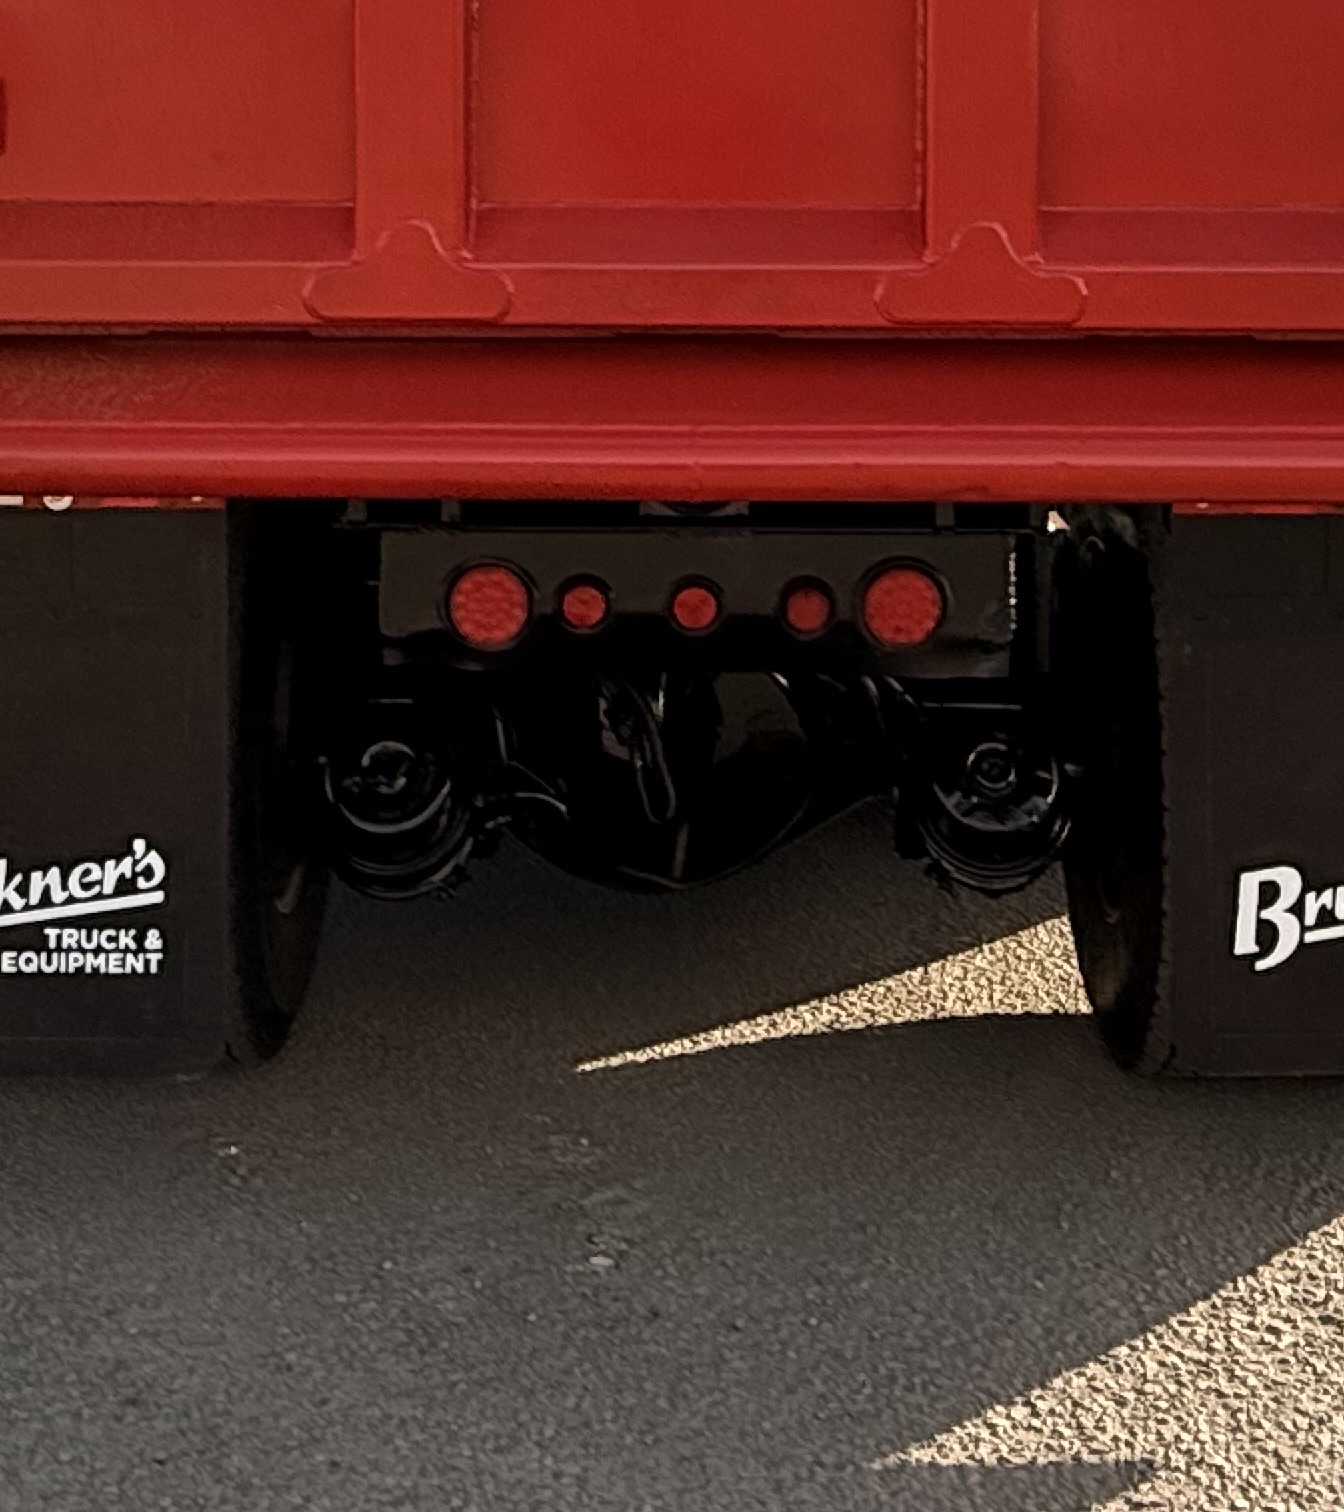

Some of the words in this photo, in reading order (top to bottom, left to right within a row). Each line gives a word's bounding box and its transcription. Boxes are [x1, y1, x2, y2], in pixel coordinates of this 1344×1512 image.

[44, 928, 136, 950] TRUCK
[144, 928, 163, 950] &
[0, 951, 163, 974] EQUIPMENT
